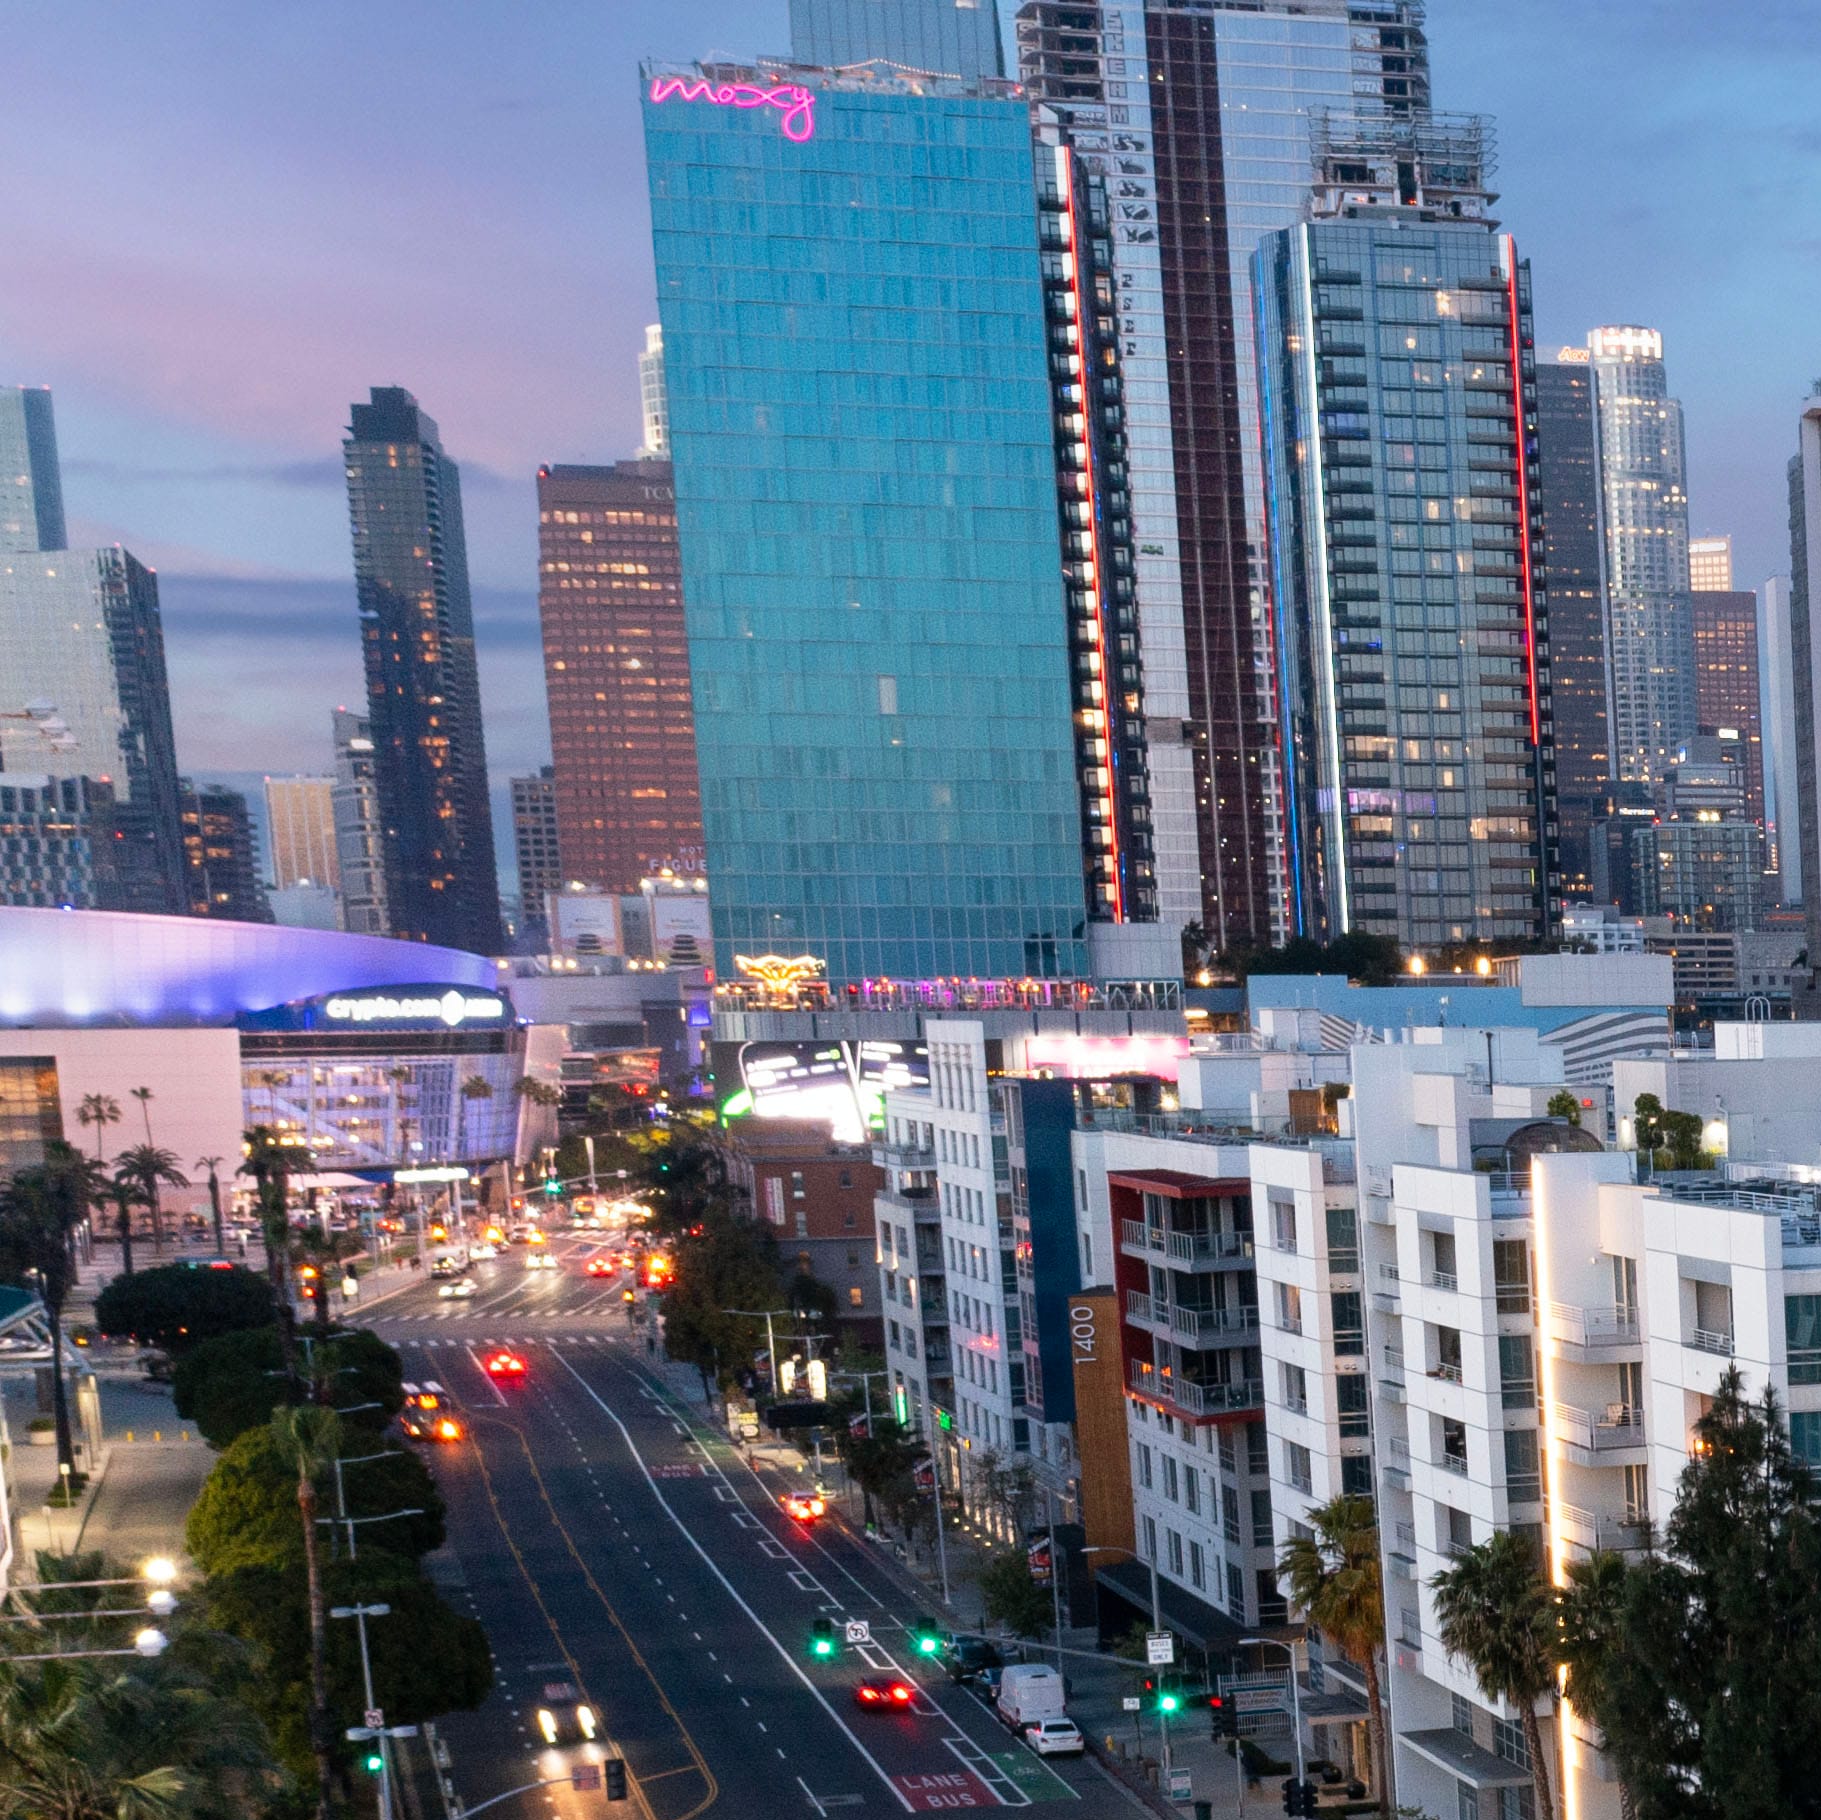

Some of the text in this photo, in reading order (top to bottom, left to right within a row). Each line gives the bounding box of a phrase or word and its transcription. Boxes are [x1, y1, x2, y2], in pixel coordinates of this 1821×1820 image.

[651, 79, 815, 142] moxy
[1071, 1306, 1097, 1365] 1400
[902, 1774, 968, 1789] LANE
[926, 1793, 976, 1808] BUS
